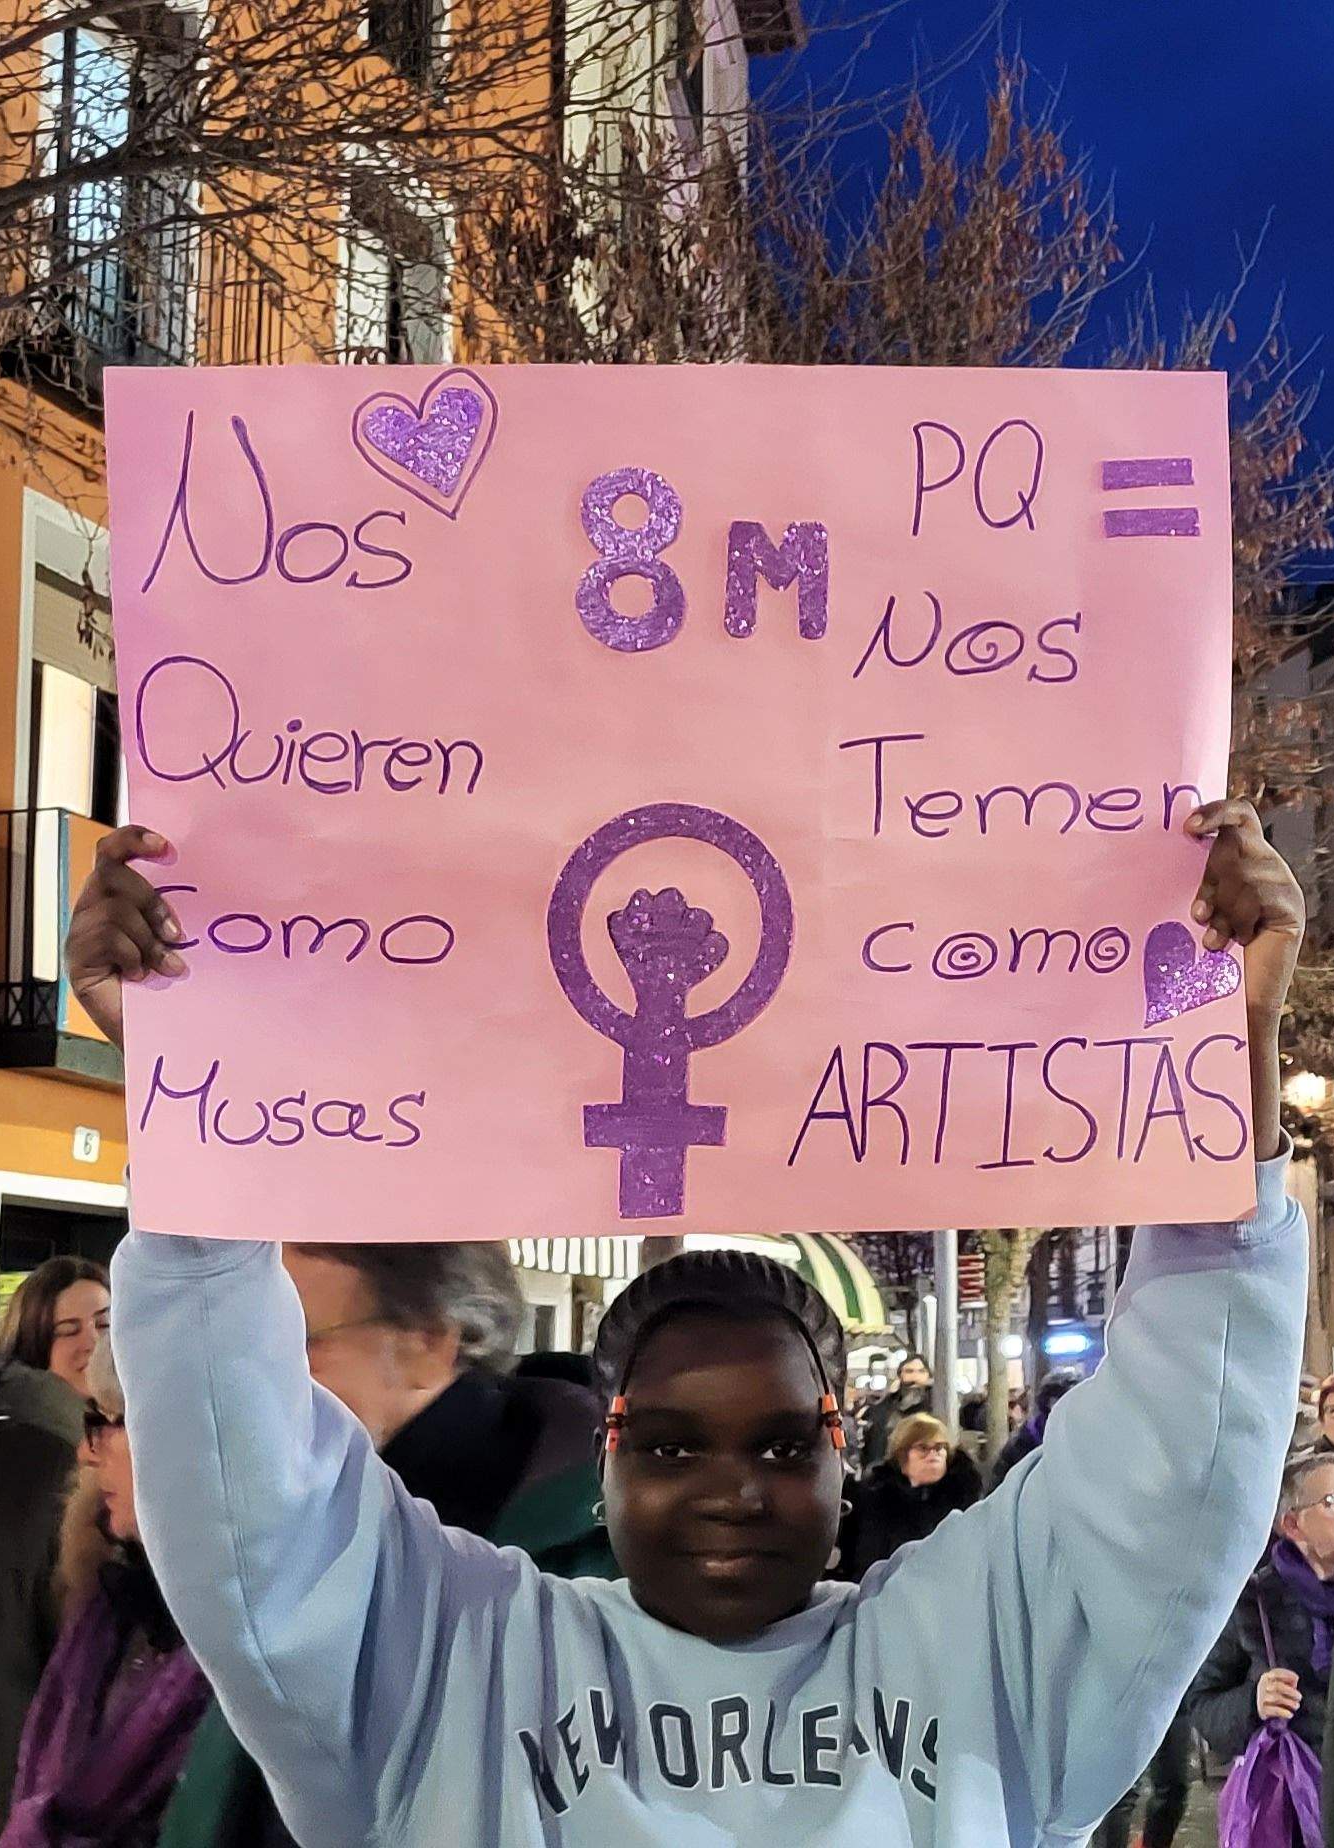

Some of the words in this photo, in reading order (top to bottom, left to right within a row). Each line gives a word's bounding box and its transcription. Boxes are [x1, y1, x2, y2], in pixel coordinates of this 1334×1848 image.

[142, 410, 413, 593] Nos
[912, 419, 1044, 537] PQ
[852, 591, 1082, 683] Nos
[135, 655, 484, 795] Quieren
[838, 732, 1204, 839] Temen
[83, 1132, 92, 1156] 6
[140, 1055, 426, 1147] Musas
[787, 1033, 1248, 1170] ARTISTAS
